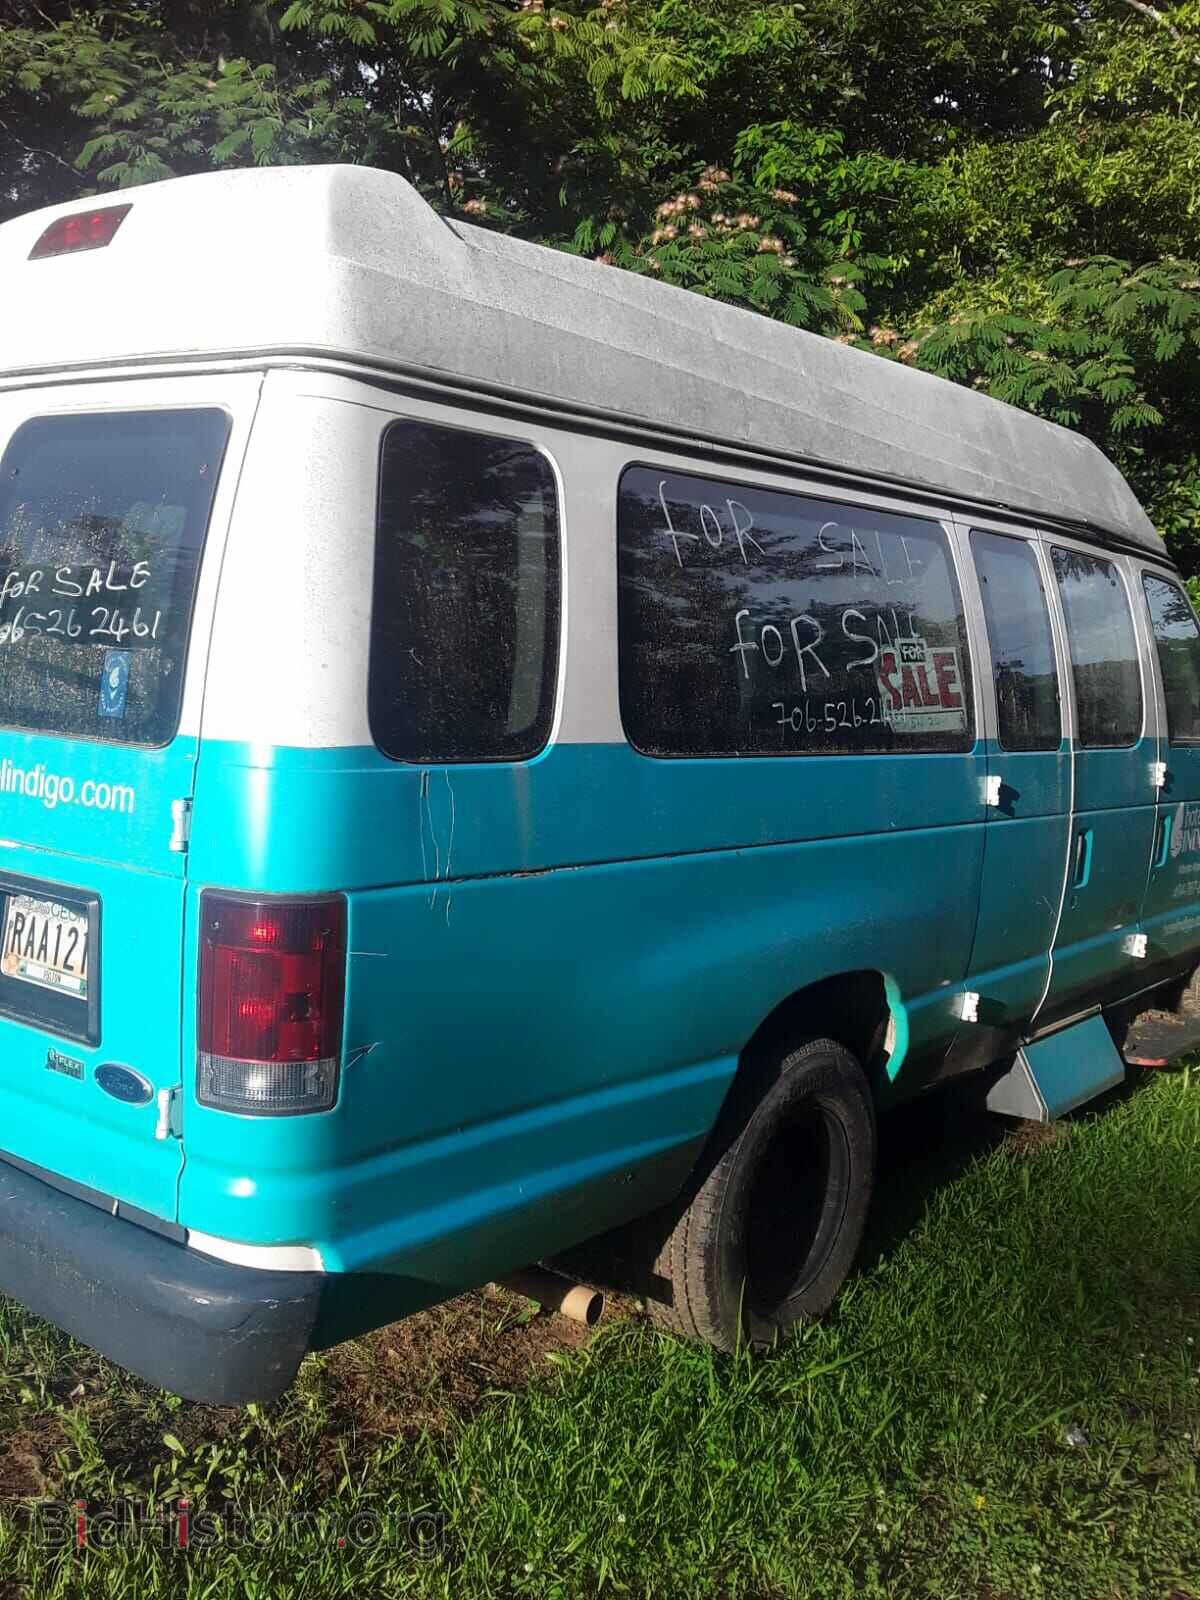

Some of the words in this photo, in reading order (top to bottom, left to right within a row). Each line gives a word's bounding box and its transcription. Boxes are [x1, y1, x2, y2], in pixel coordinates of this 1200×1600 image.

[52, 561, 151, 597] SALE
[90, 606, 162, 642] 2461
[902, 644, 925, 661] FOR
[880, 652, 963, 712] SALE
